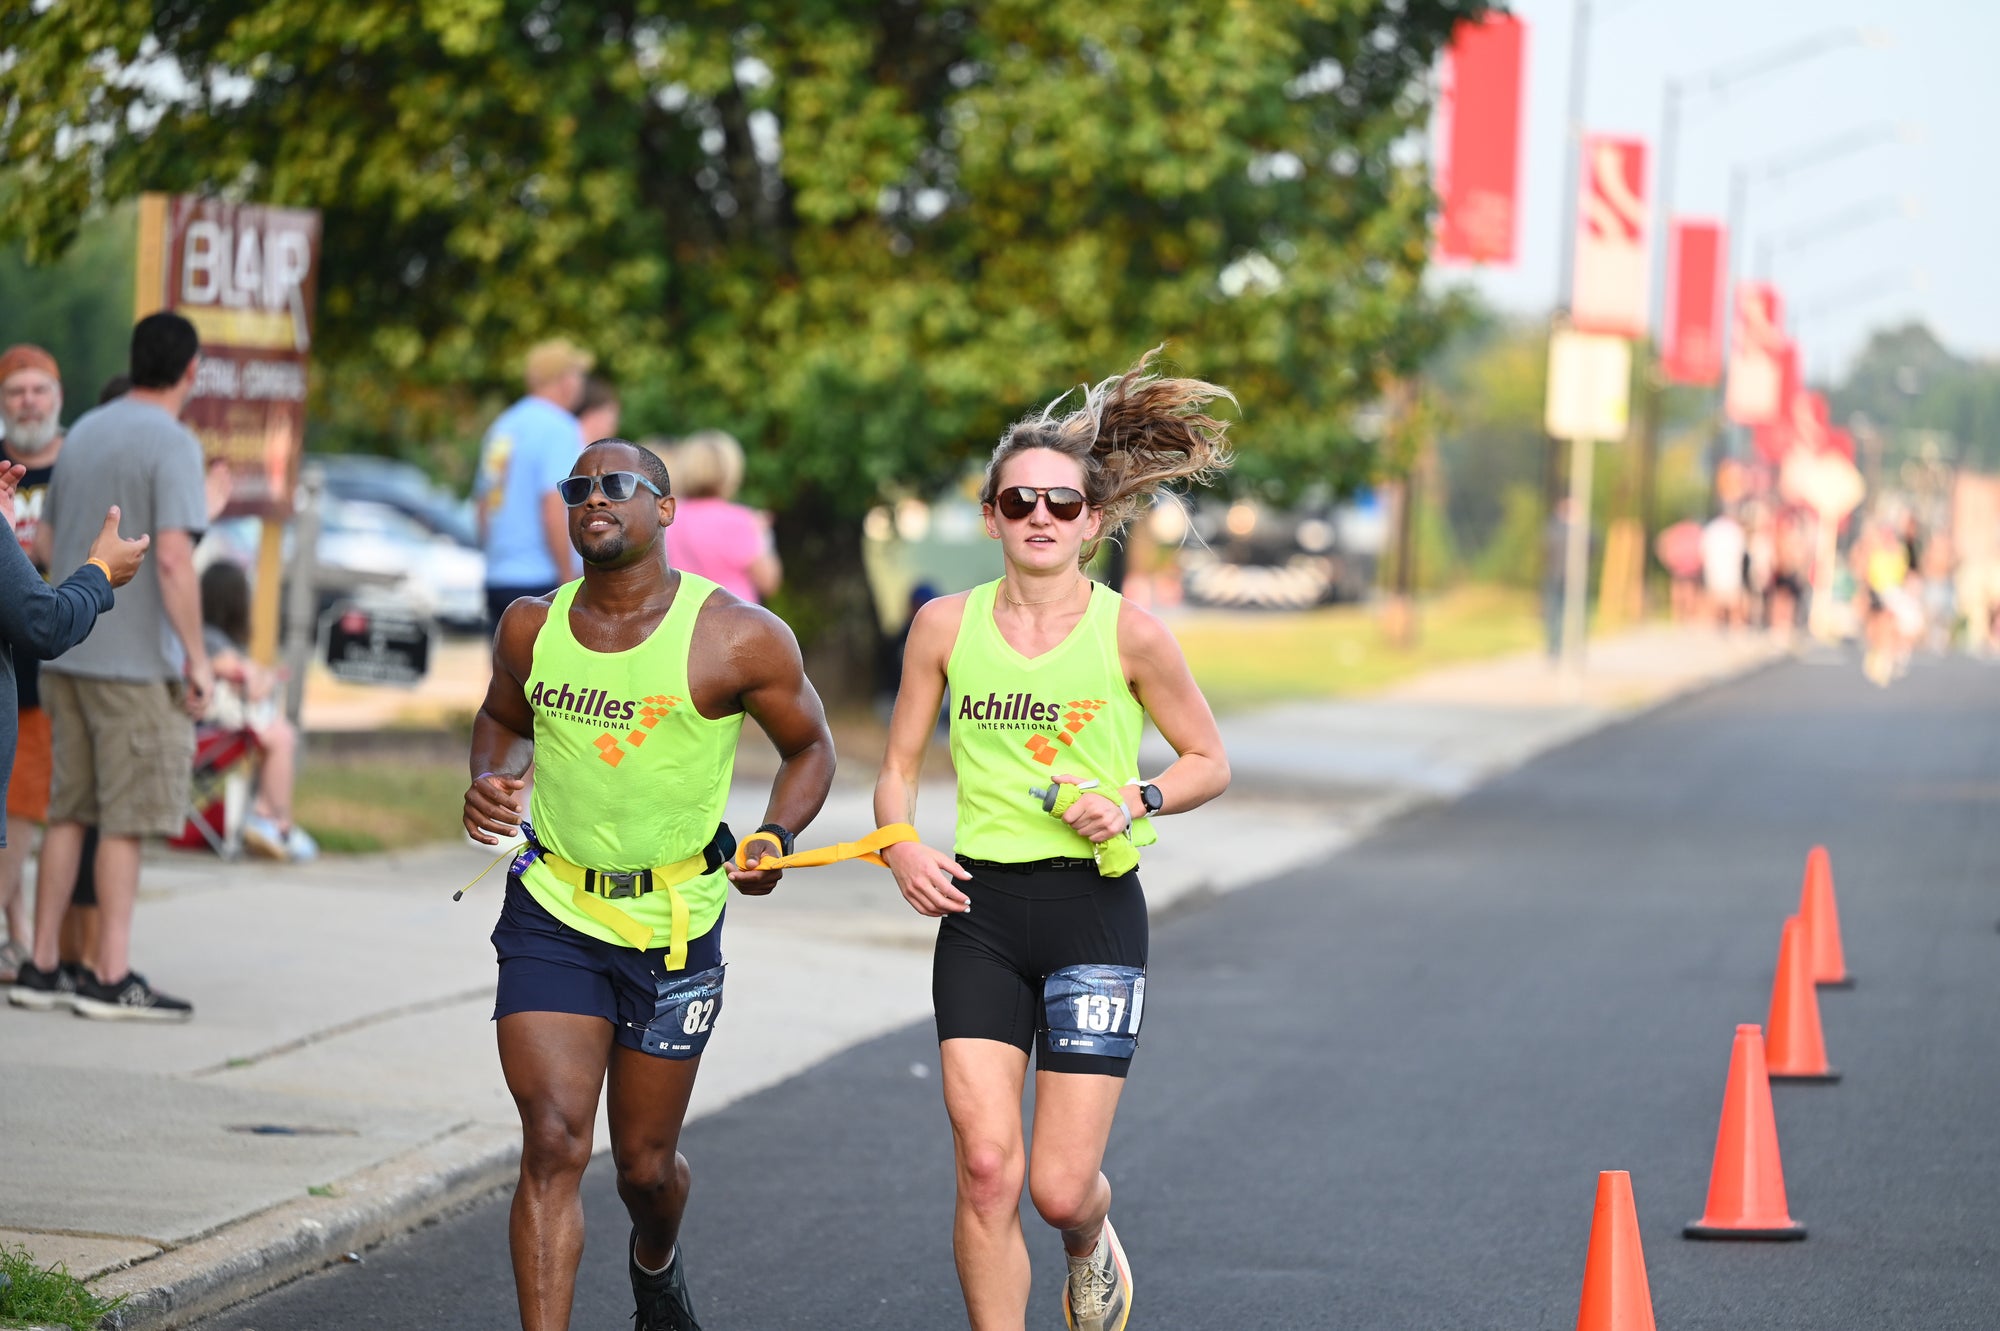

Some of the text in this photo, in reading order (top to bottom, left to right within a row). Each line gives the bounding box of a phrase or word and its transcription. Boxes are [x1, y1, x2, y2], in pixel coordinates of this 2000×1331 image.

[182, 220, 310, 354] BLAIR
[530, 681, 636, 721] Achilles
[958, 692, 1061, 723] Achilles
[546, 710, 631, 731] INTERNATIONAL
[977, 722, 1059, 732] INTERNATIONAL
[683, 998, 715, 1035] 82
[1073, 994, 1126, 1033] 137
[659, 1041, 669, 1050] 82
[1059, 1038, 1069, 1047] 137
